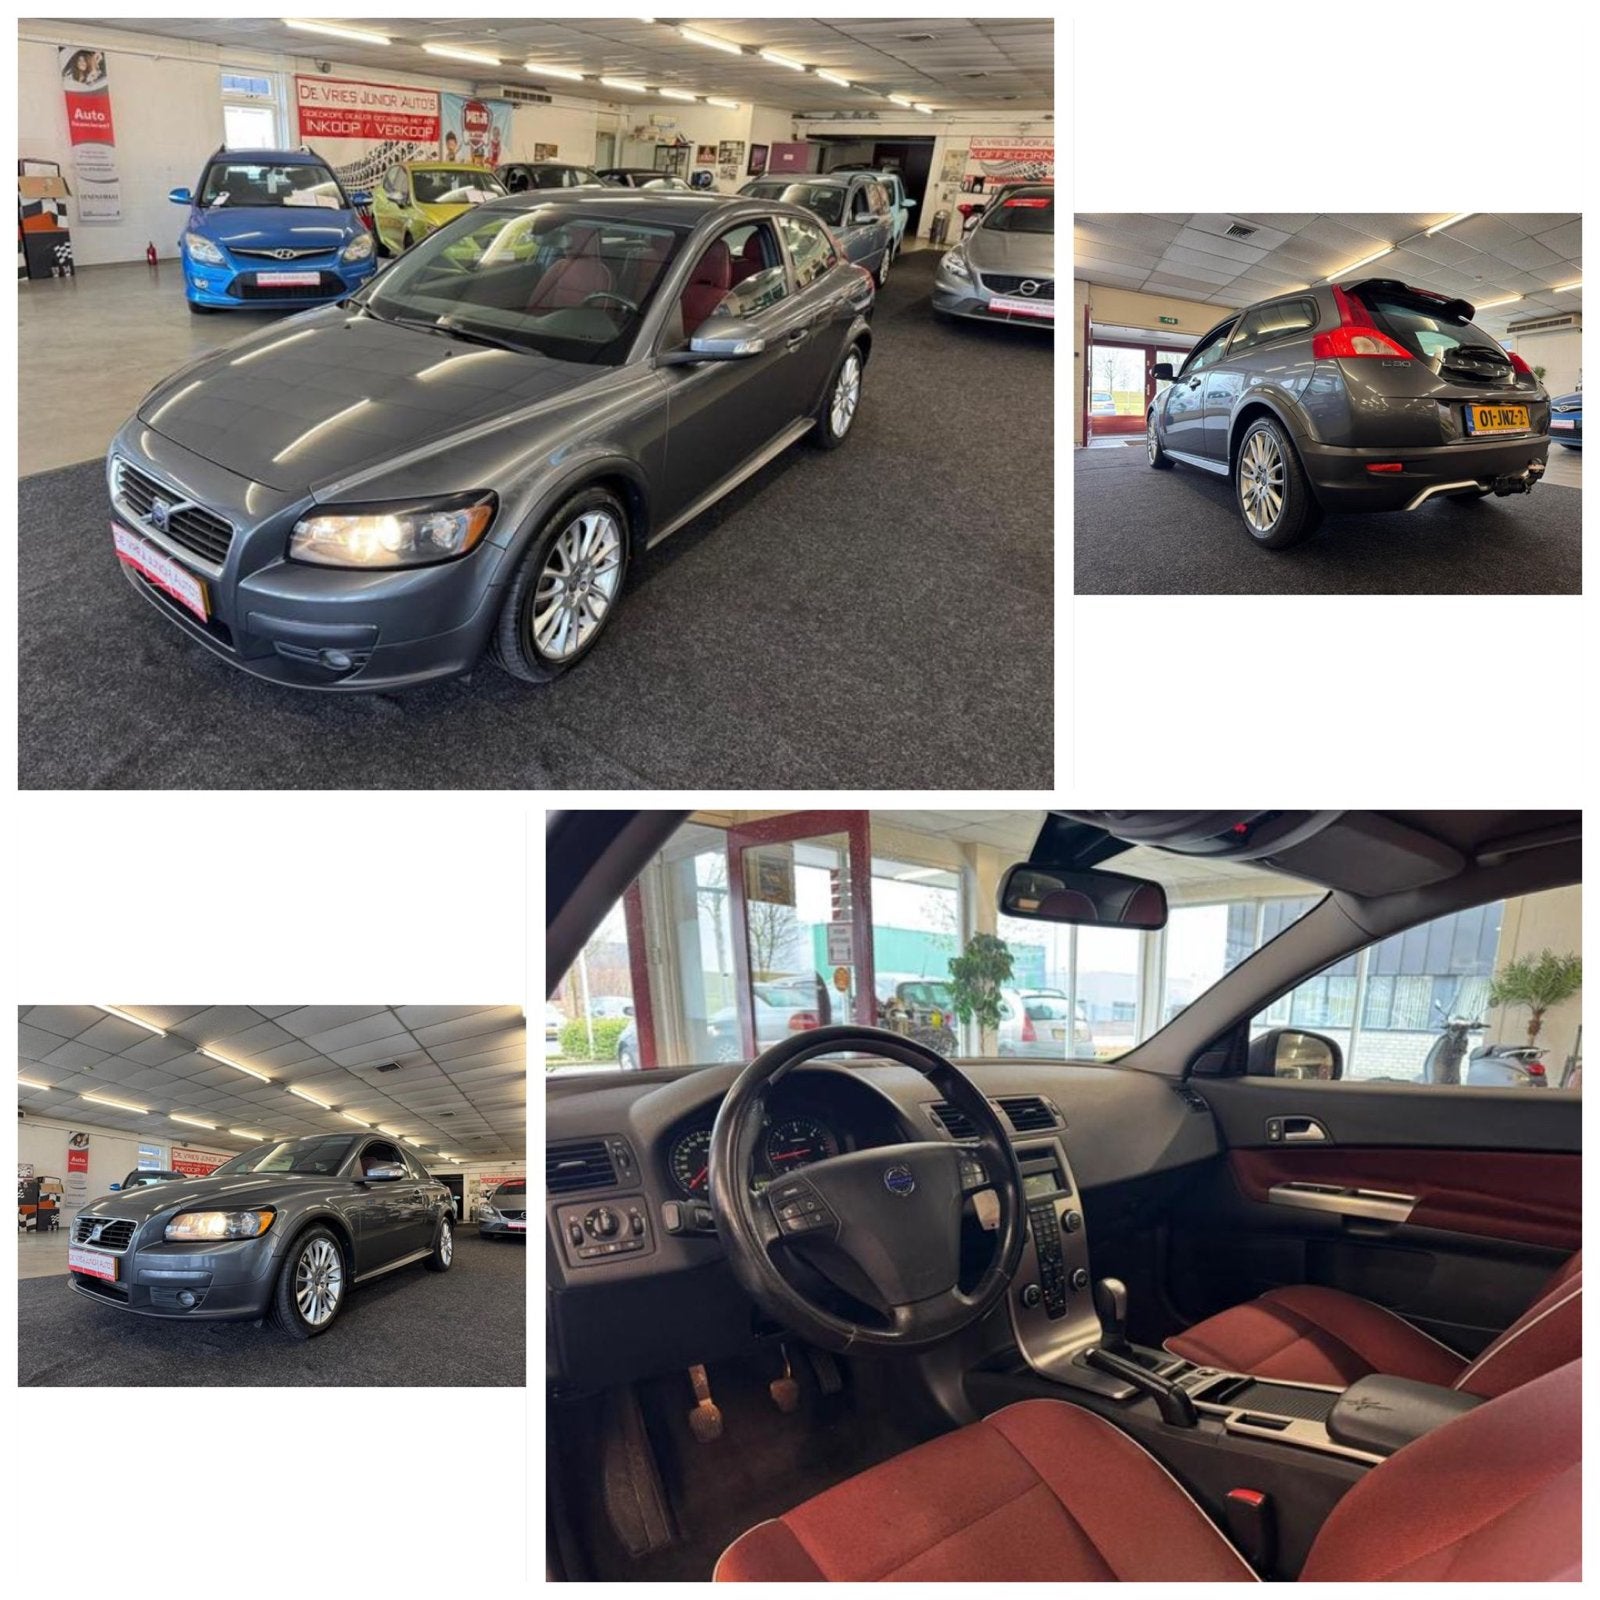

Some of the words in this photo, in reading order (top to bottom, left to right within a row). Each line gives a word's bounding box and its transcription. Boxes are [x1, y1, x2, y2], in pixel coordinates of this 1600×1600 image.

[300, 85, 319, 100] DE
[321, 87, 358, 103] VRIES
[360, 91, 397, 107] JUNIOR
[400, 95, 436, 110] AUTO'S
[74, 107, 105, 121] Auto
[306, 119, 361, 134] INKOOP
[375, 122, 435, 138] VERKOOP
[1480, 408, 1526, 427] 01-JNZ-2
